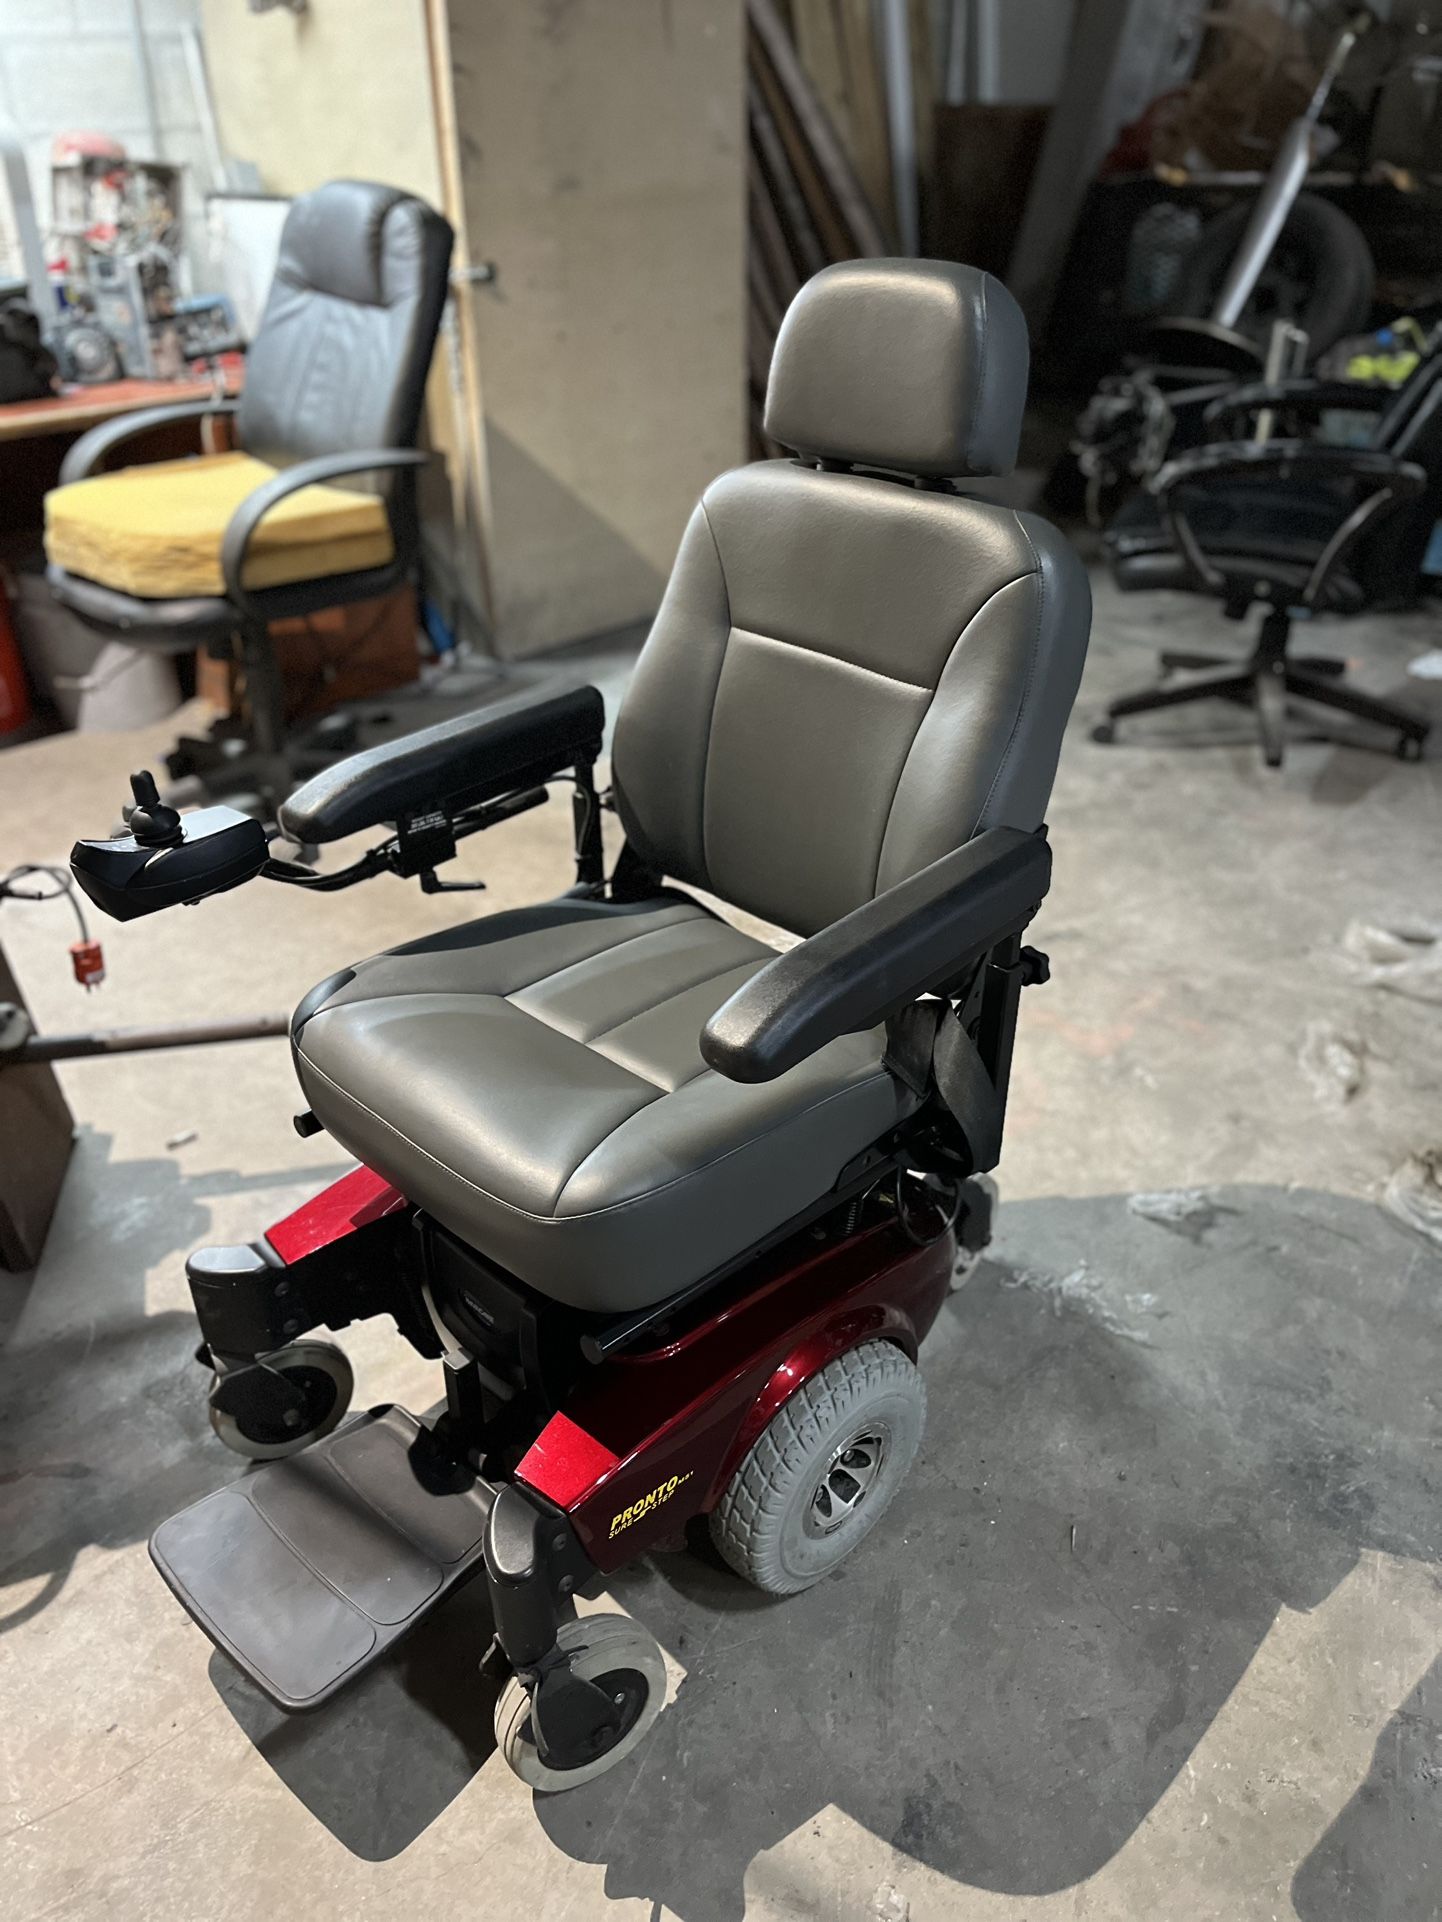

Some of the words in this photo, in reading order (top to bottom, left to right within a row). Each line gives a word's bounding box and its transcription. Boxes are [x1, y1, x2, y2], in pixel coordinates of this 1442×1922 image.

[608, 1517, 633, 1539] SURE
[651, 1489, 675, 1510] STEP
[610, 1475, 678, 1531] PRONTO
